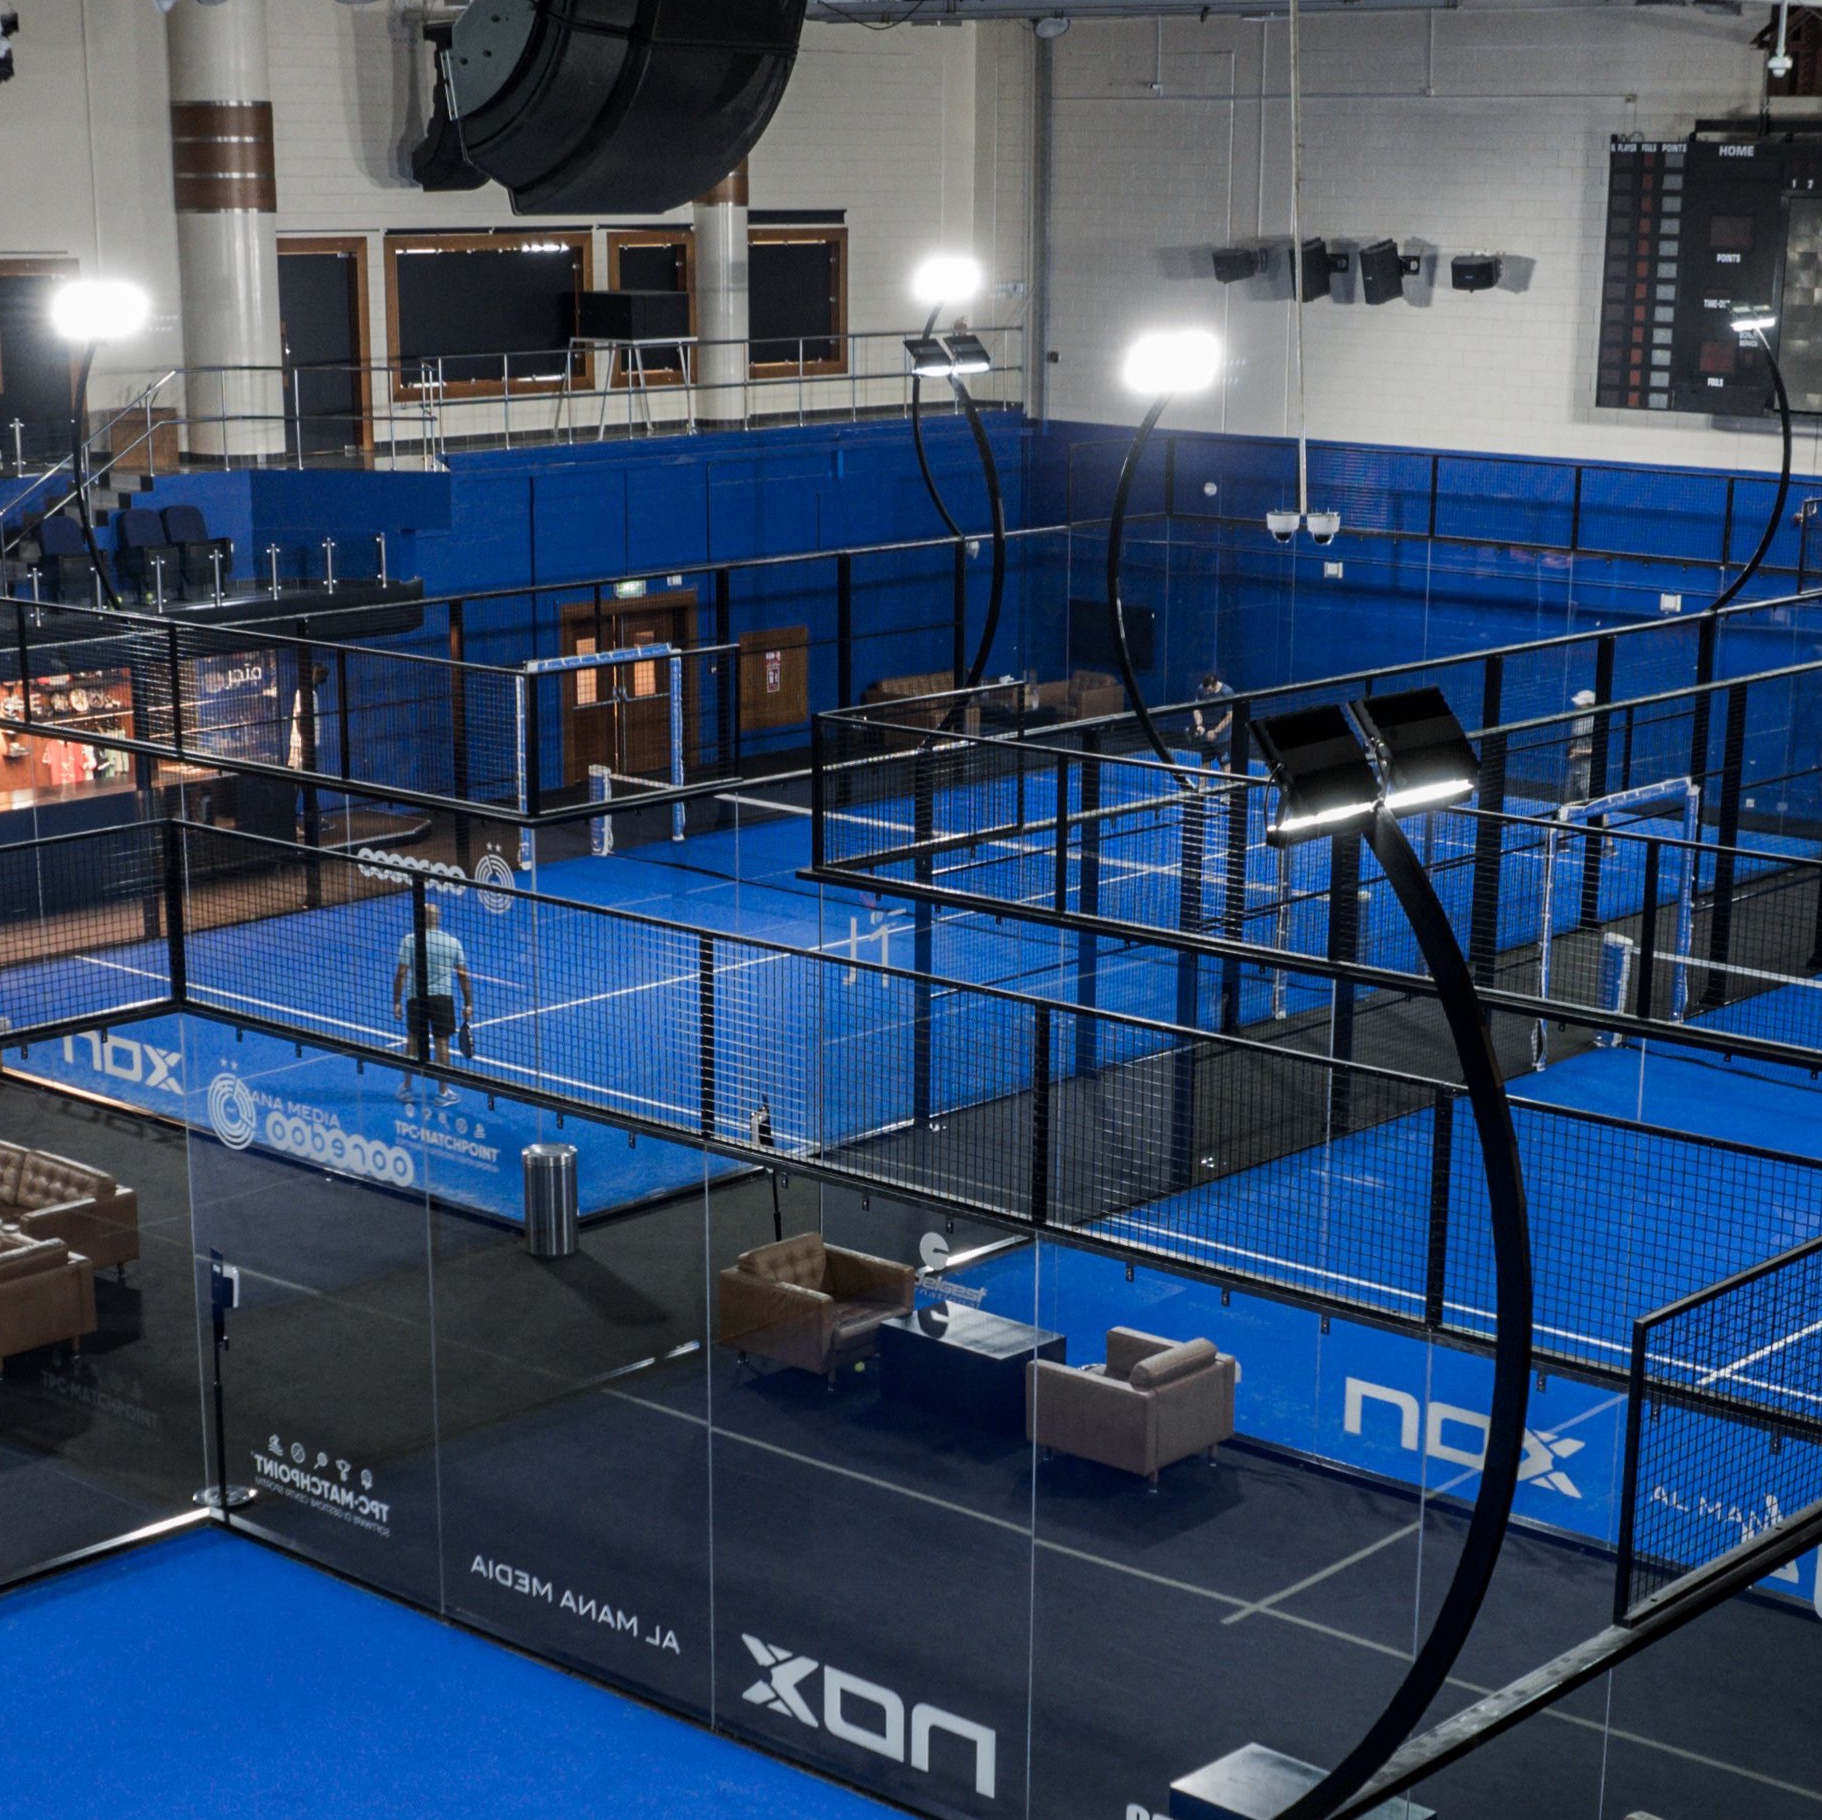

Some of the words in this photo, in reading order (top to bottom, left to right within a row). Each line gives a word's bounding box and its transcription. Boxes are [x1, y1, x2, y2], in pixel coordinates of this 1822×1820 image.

[1662, 143, 1687, 153] POINTS
[1719, 145, 1755, 157] HOME
[1807, 179, 1814, 189] 2
[1716, 253, 1741, 264] POINTS
[247, 1089, 283, 1112] ANA
[288, 1100, 341, 1128] MEDIA
[1650, 1486, 1688, 1512] AL
